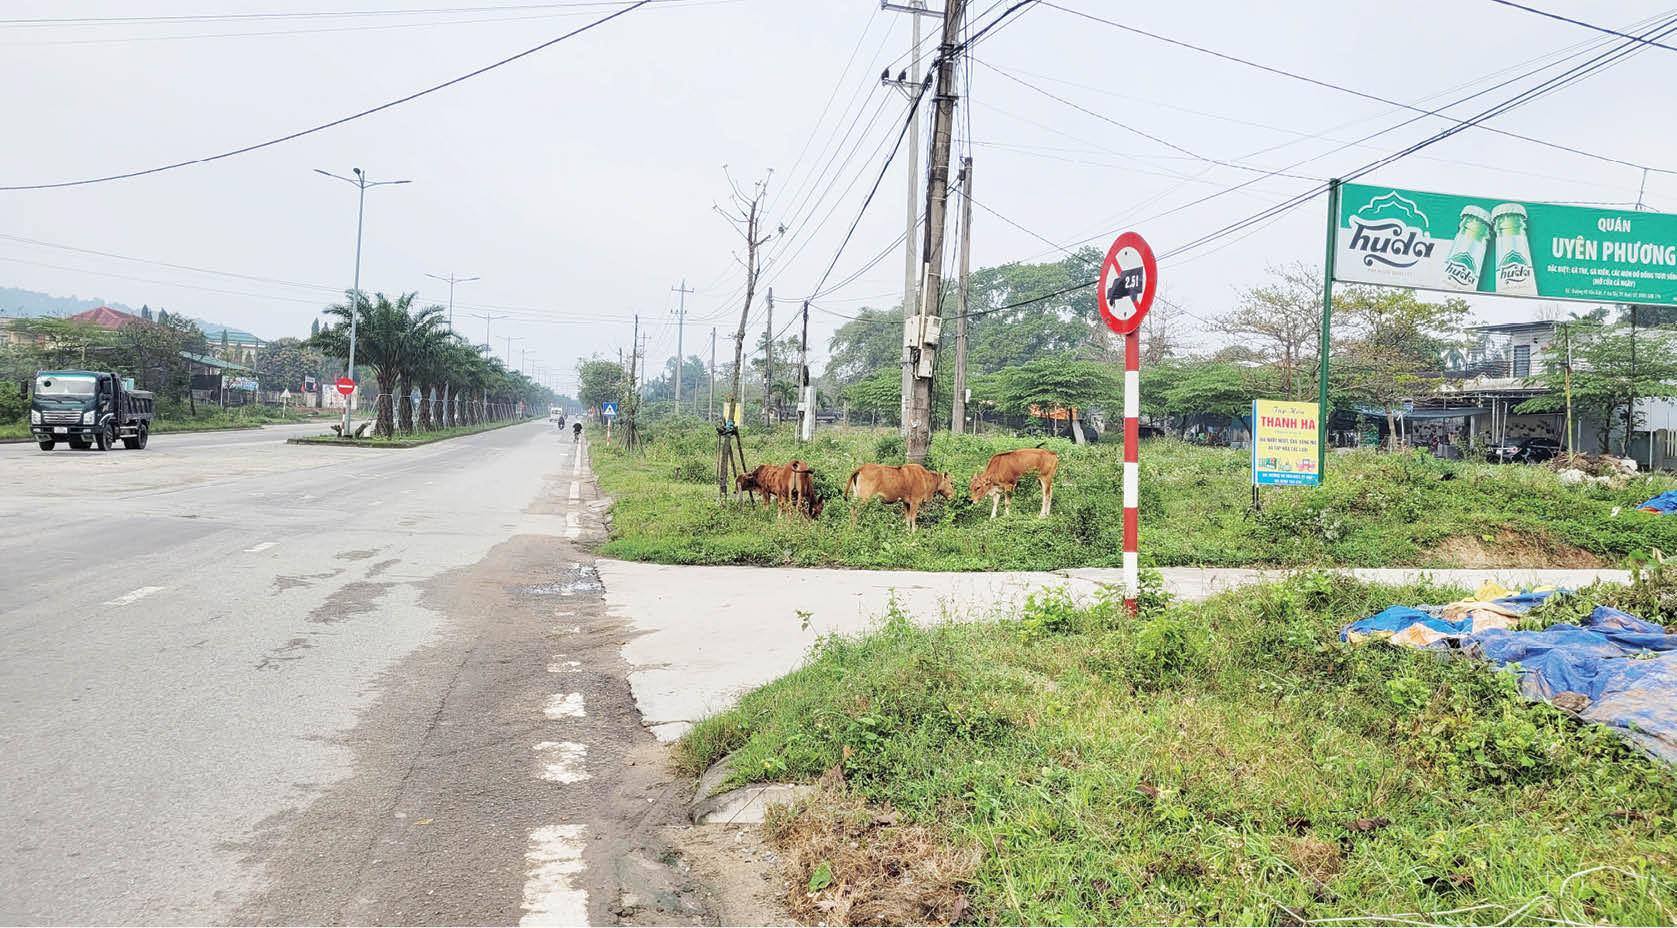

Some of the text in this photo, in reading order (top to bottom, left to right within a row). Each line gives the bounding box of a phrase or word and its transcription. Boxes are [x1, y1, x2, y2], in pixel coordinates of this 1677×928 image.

[1597, 216, 1631, 232] QUÁN
[1349, 221, 1435, 258] huda
[1552, 235, 1676, 266] UYÊN PHƯƠNG
[1445, 262, 1475, 285] huda
[1500, 263, 1530, 279] huda
[1261, 416, 1297, 429] THANH
